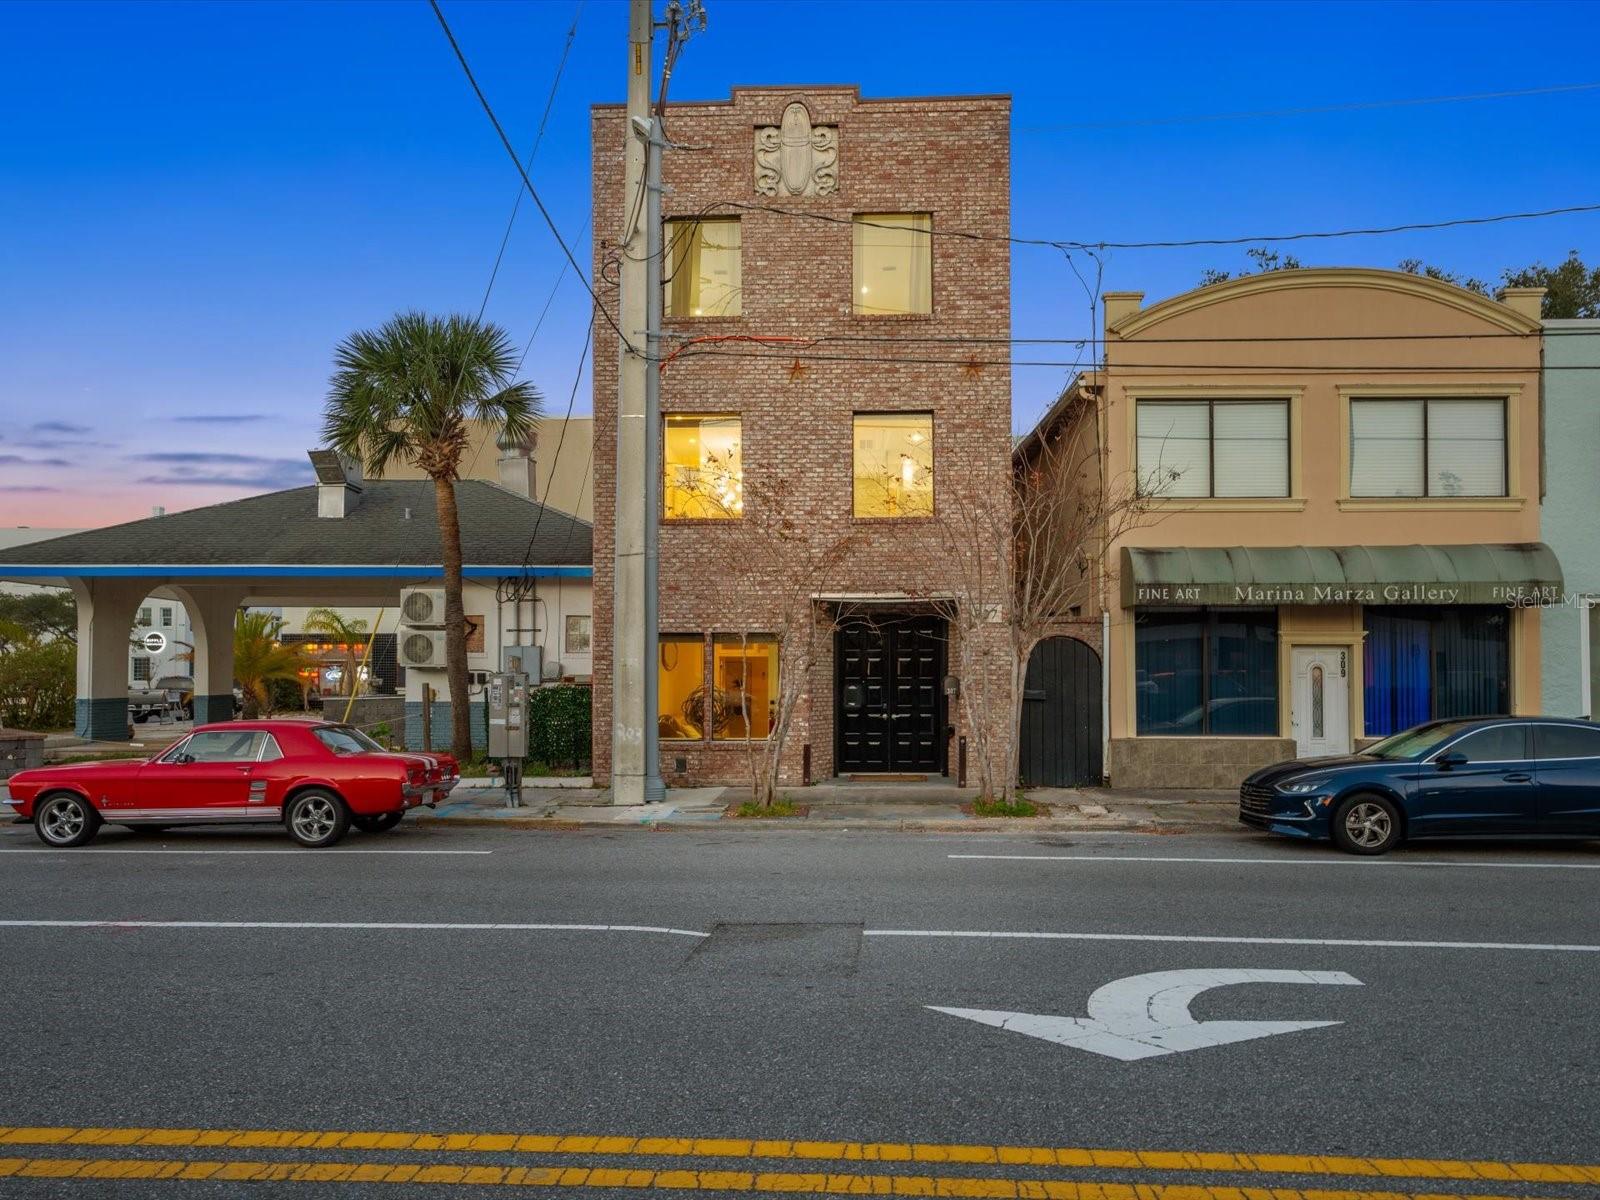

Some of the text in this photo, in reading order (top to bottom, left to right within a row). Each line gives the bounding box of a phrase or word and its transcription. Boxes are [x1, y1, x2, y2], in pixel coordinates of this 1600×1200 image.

[1139, 588, 1200, 600] FINE ART
[1235, 585, 1459, 603] Marina Marza Gallery
[1493, 586, 1558, 599] FINE ART
